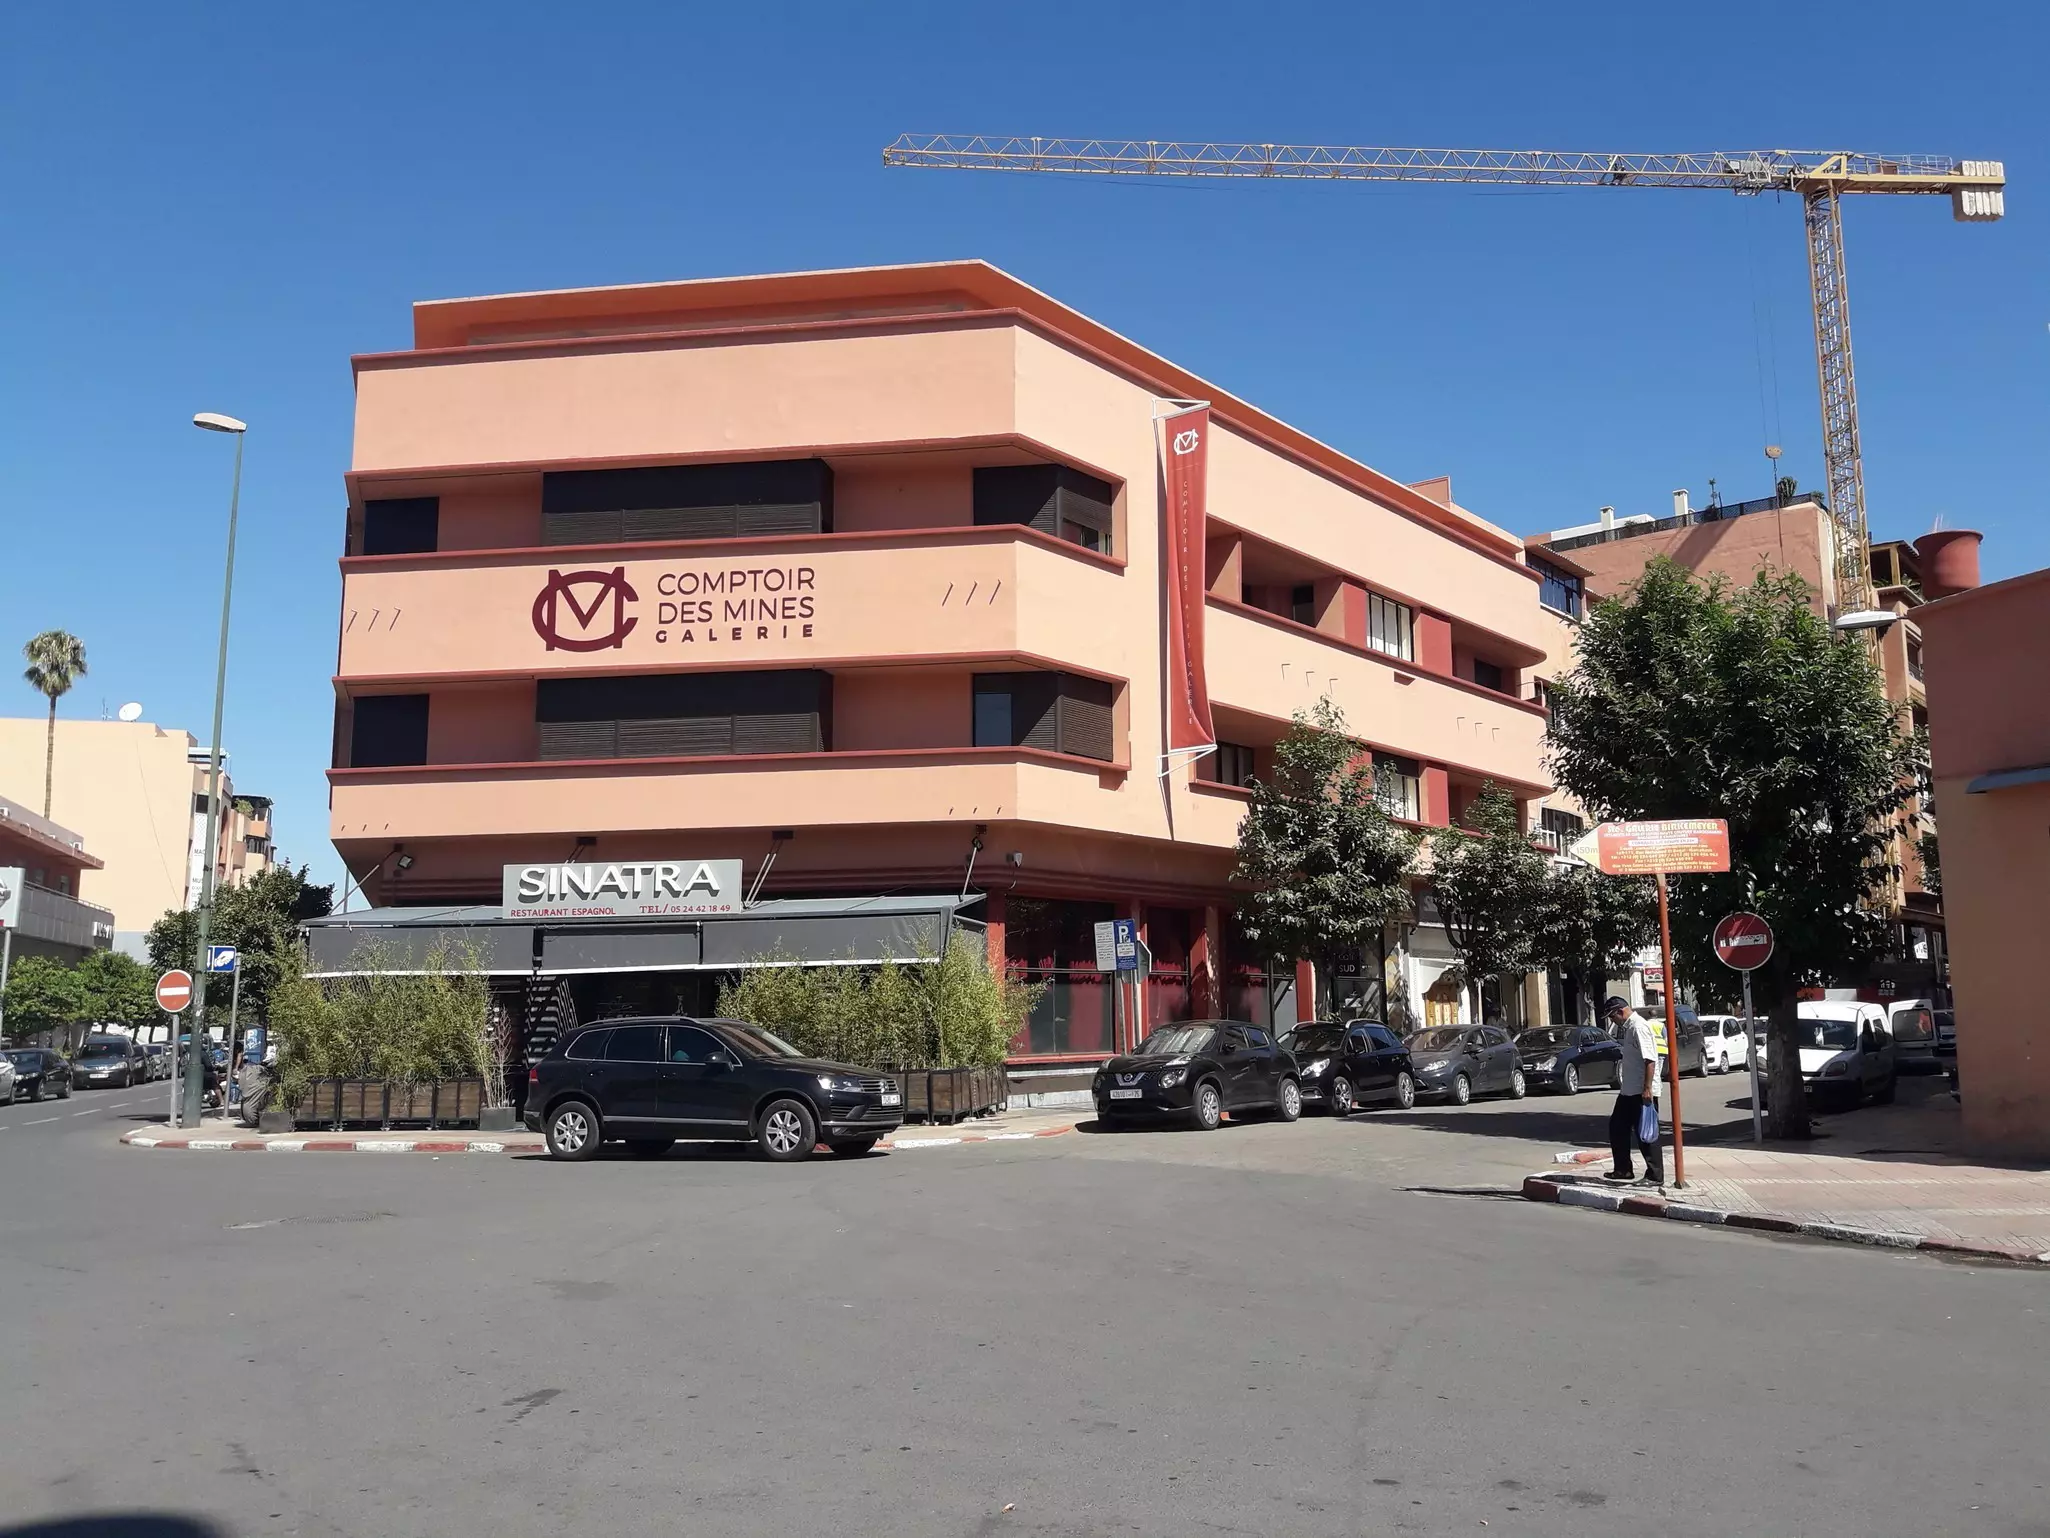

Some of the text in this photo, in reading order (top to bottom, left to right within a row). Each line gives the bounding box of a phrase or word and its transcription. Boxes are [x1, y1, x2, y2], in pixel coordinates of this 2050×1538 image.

[657, 567, 815, 596] COMPTOIR
[658, 596, 815, 625] DES MINES
[655, 623, 813, 643] GALERIE
[1661, 821, 1718, 831] BIRKEMEYER
[1576, 846, 1598, 855] 150m
[518, 863, 721, 903] SINATRA
[510, 908, 569, 917] RESTAURANT
[571, 906, 616, 916] ESPAGNOL
[682, 905, 694, 913] 24
[695, 905, 707, 913] 42
[719, 904, 731, 912] 49
